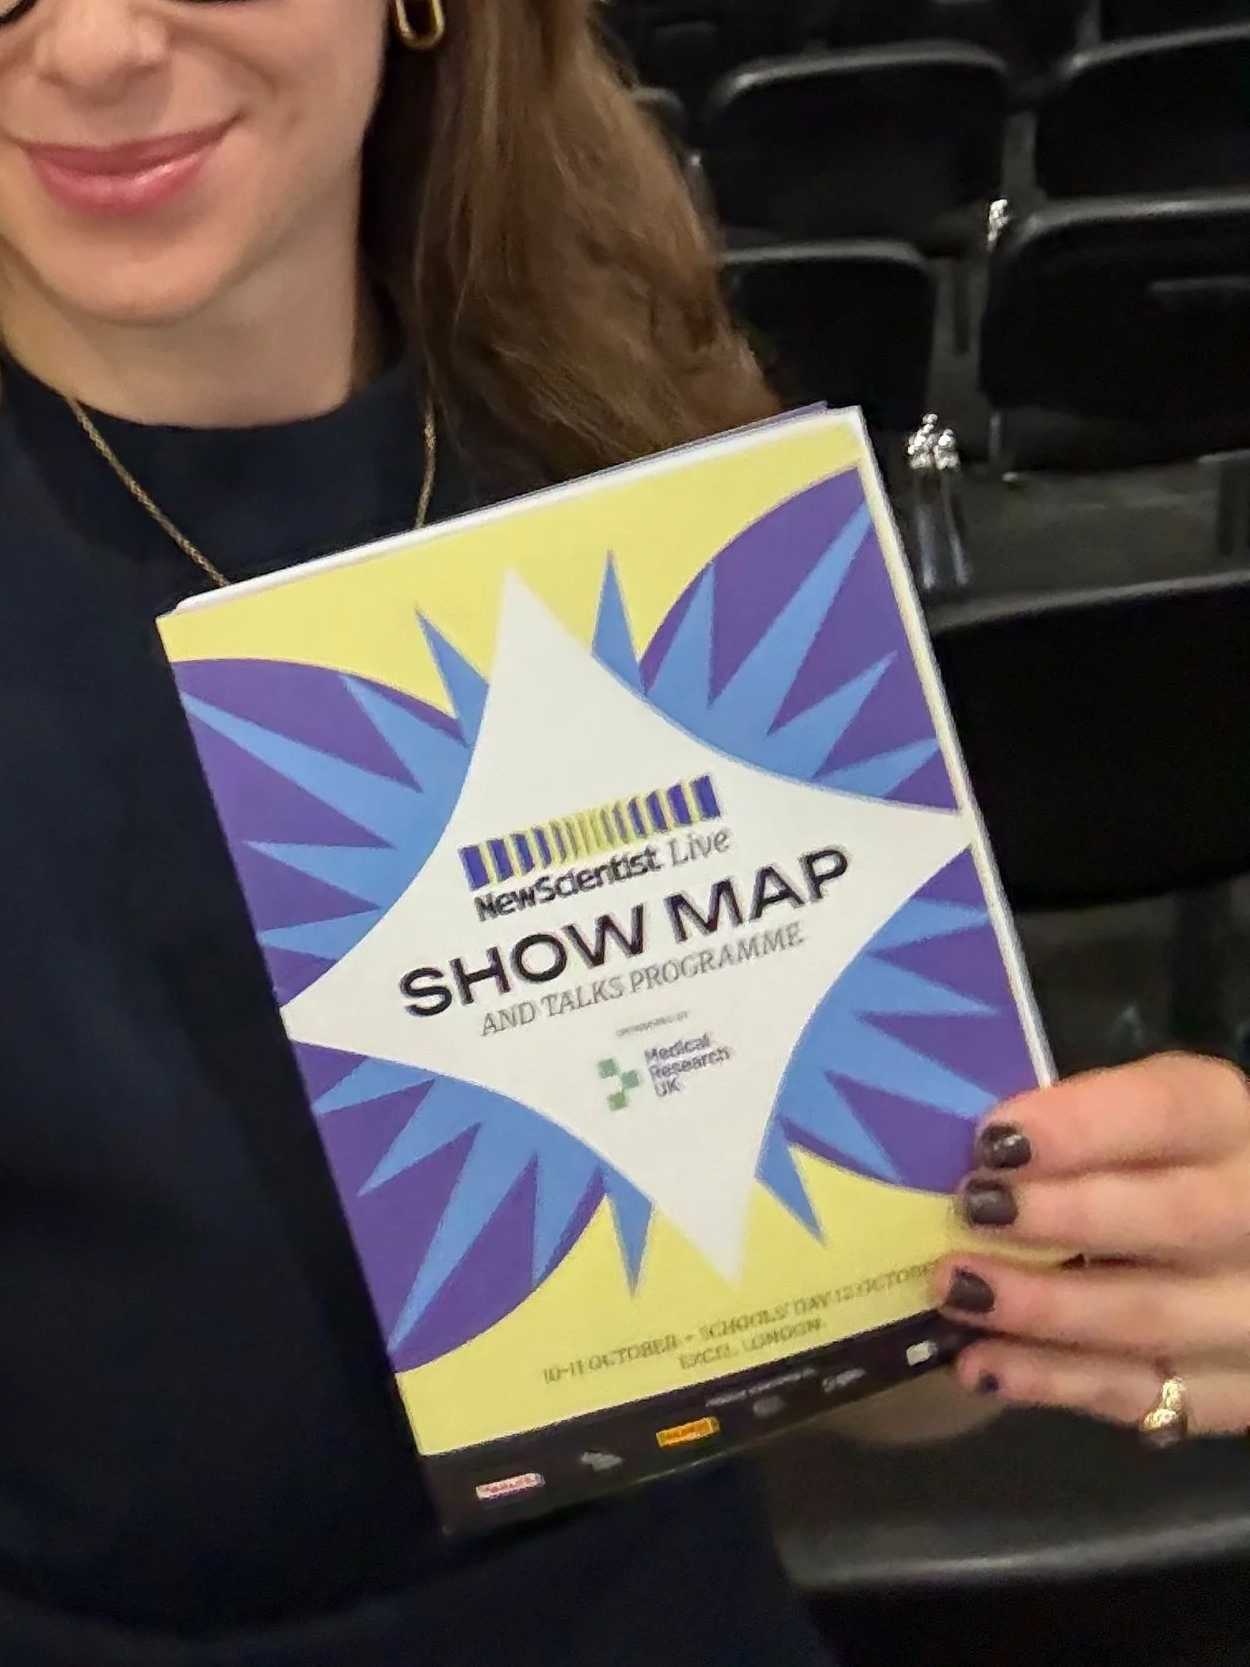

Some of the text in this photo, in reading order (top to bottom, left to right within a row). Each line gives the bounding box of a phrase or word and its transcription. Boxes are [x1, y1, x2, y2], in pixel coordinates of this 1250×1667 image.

[474, 828, 731, 922] NewScientist Live
[399, 847, 850, 1018] SHOW MAP
[481, 922, 806, 1037] AND TALKS PROGRAMME
[644, 1033, 711, 1066] Medical
[648, 1045, 731, 1082] Research
[653, 1074, 681, 1097] UK
[587, 1333, 678, 1371] OCTOBER
[791, 1291, 832, 1319] DAY
[740, 1318, 823, 1355] LONDON
